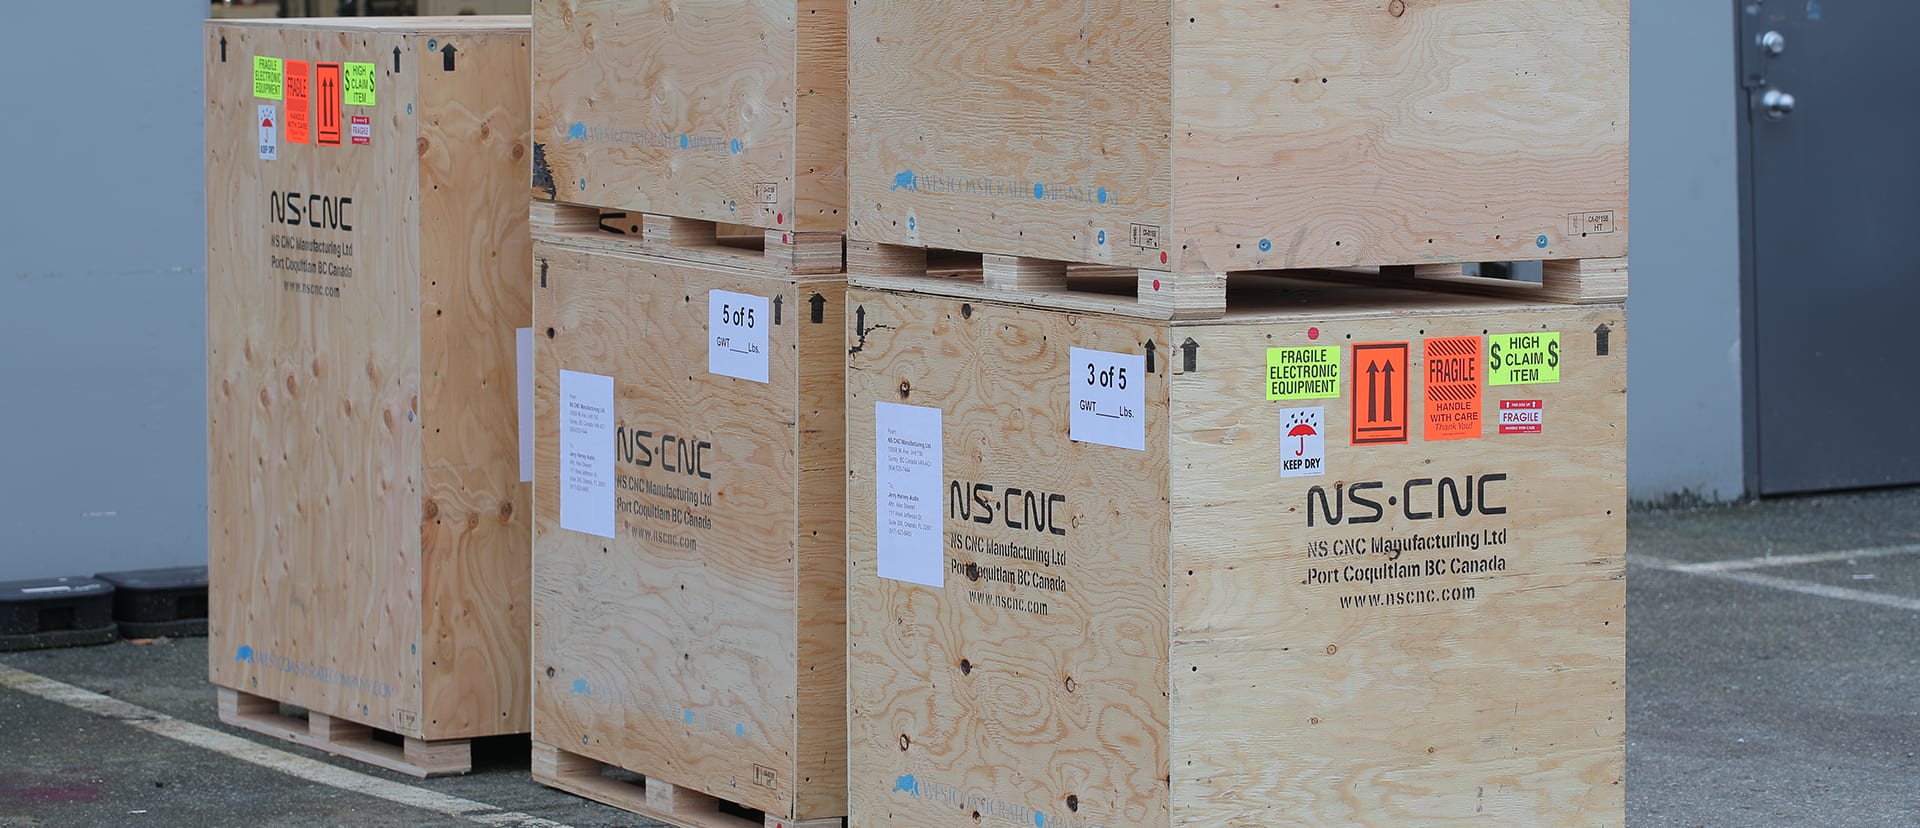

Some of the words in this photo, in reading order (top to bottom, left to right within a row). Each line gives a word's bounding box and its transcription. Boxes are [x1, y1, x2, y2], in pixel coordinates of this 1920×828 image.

[259, 58, 277, 71] FRAGILE
[352, 65, 366, 76] HIGH
[255, 70, 281, 83] ELECTRONIC
[351, 78, 368, 90] CLAIM
[256, 82, 281, 95] EQUIPMENT
[287, 76, 306, 98] FRAGILE
[353, 92, 367, 103] ITEM
[271, 235, 280, 248] NS
[281, 236, 295, 249] CNC
[296, 238, 341, 258] Manufacturing
[342, 242, 353, 256] Ltd
[271, 255, 285, 269] Port
[285, 257, 316, 274] Coquitlam
[318, 261, 328, 274] BC
[328, 262, 353, 278] Canada
[283, 280, 340, 297] www.nscnc.com
[722, 304, 730, 324] 5
[733, 307, 745, 326] of
[748, 309, 755, 328] 5
[1509, 335, 1540, 350] HIGH
[1281, 349, 1327, 364] FRAGILE
[1490, 341, 1501, 374] $
[1505, 351, 1544, 367] CLAIM
[1547, 338, 1559, 371] $
[1087, 363, 1095, 386] 3
[1100, 366, 1115, 388] of
[1118, 368, 1127, 390] 5
[1270, 363, 1338, 380] ELECTRONIC
[1429, 357, 1475, 383] FRAGILE
[1510, 368, 1539, 382] ITEM
[1271, 379, 1336, 395] EQUIPMENT
[1436, 401, 1472, 411] HANDLE
[1430, 413, 1453, 423] WITH
[1454, 411, 1478, 421] CARE
[1503, 412, 1539, 422] FRAGILE
[1435, 421, 1460, 431] Thank
[1460, 421, 1473, 430] You!
[1283, 459, 1303, 471] KEEP
[1304, 457, 1321, 469] DRY
[616, 475, 627, 489] NS
[628, 477, 645, 493] CNC
[646, 481, 699, 507] Manufacturing
[700, 491, 712, 506] Ltd
[616, 497, 632, 513] Port
[633, 501, 671, 520] Coquitlam
[671, 508, 683, 524] BC
[683, 511, 712, 530] Canada
[631, 526, 697, 551] www.nscnc.com
[1307, 540, 1328, 558] NS
[1333, 537, 1366, 556] CNC
[1371, 531, 1480, 553] Manufacturing
[1484, 528, 1507, 546] Ltd
[950, 532, 963, 550] NS
[965, 535, 984, 553] CNC
[986, 538, 1050, 568] Manufacturing
[1051, 548, 1066, 566] Ltd
[1308, 567, 1339, 585] Port
[1343, 561, 1420, 584] Coquitlam
[1425, 558, 1446, 576] BC
[1450, 555, 1506, 575] Canada
[1017, 568, 1030, 587] BC
[1032, 571, 1066, 592] Canada
[969, 590, 1048, 616] www.nscnc.com
[1340, 585, 1475, 609] www.nscnc.com
